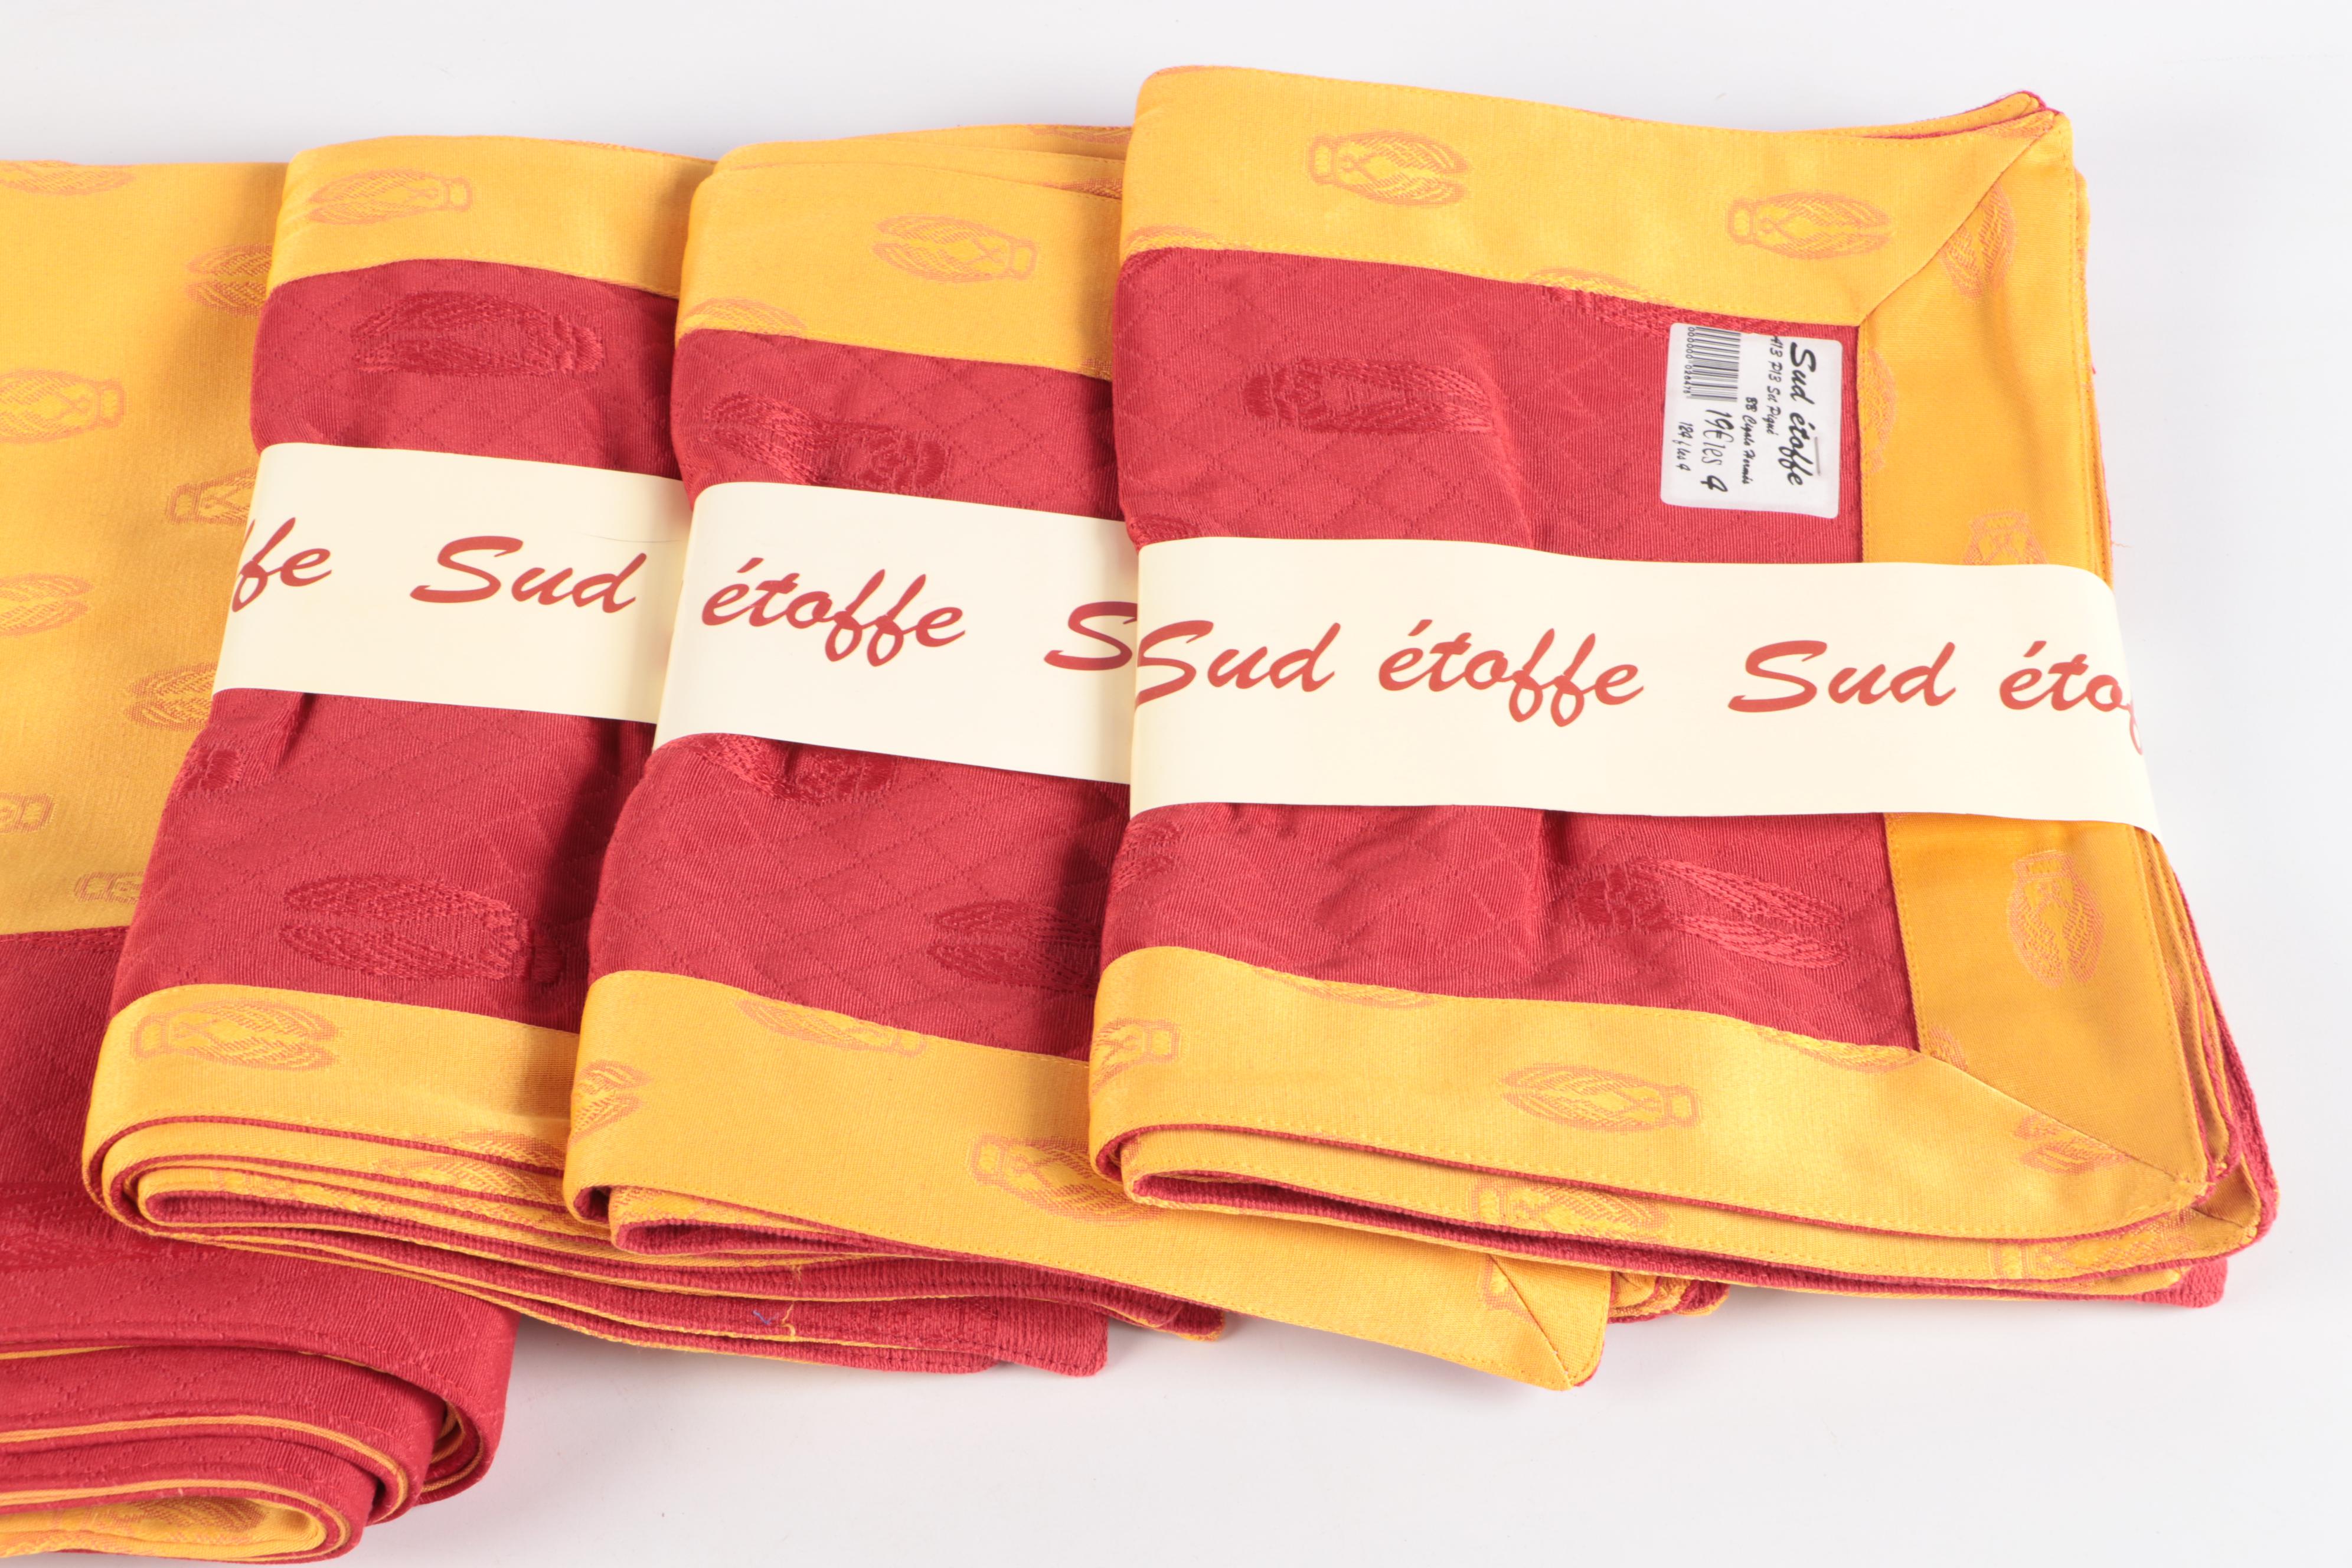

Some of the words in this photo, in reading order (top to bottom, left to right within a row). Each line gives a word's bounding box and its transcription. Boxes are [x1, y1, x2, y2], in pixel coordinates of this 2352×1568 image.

[1767, 386, 1781, 403] Set
[1768, 361, 1783, 383] P13
[1789, 341, 1817, 405] Sud
[1762, 406, 1782, 436] Piqué
[1675, 463, 1691, 472] 4
[1778, 412, 1816, 486] étoffe
[1700, 475, 1729, 492] 4
[409, 535, 647, 613] Sud
[701, 557, 966, 667] étoffe
[1133, 619, 1341, 713] Sud
[1378, 619, 1644, 728] étoffe
[1727, 639, 1956, 713] Sud
